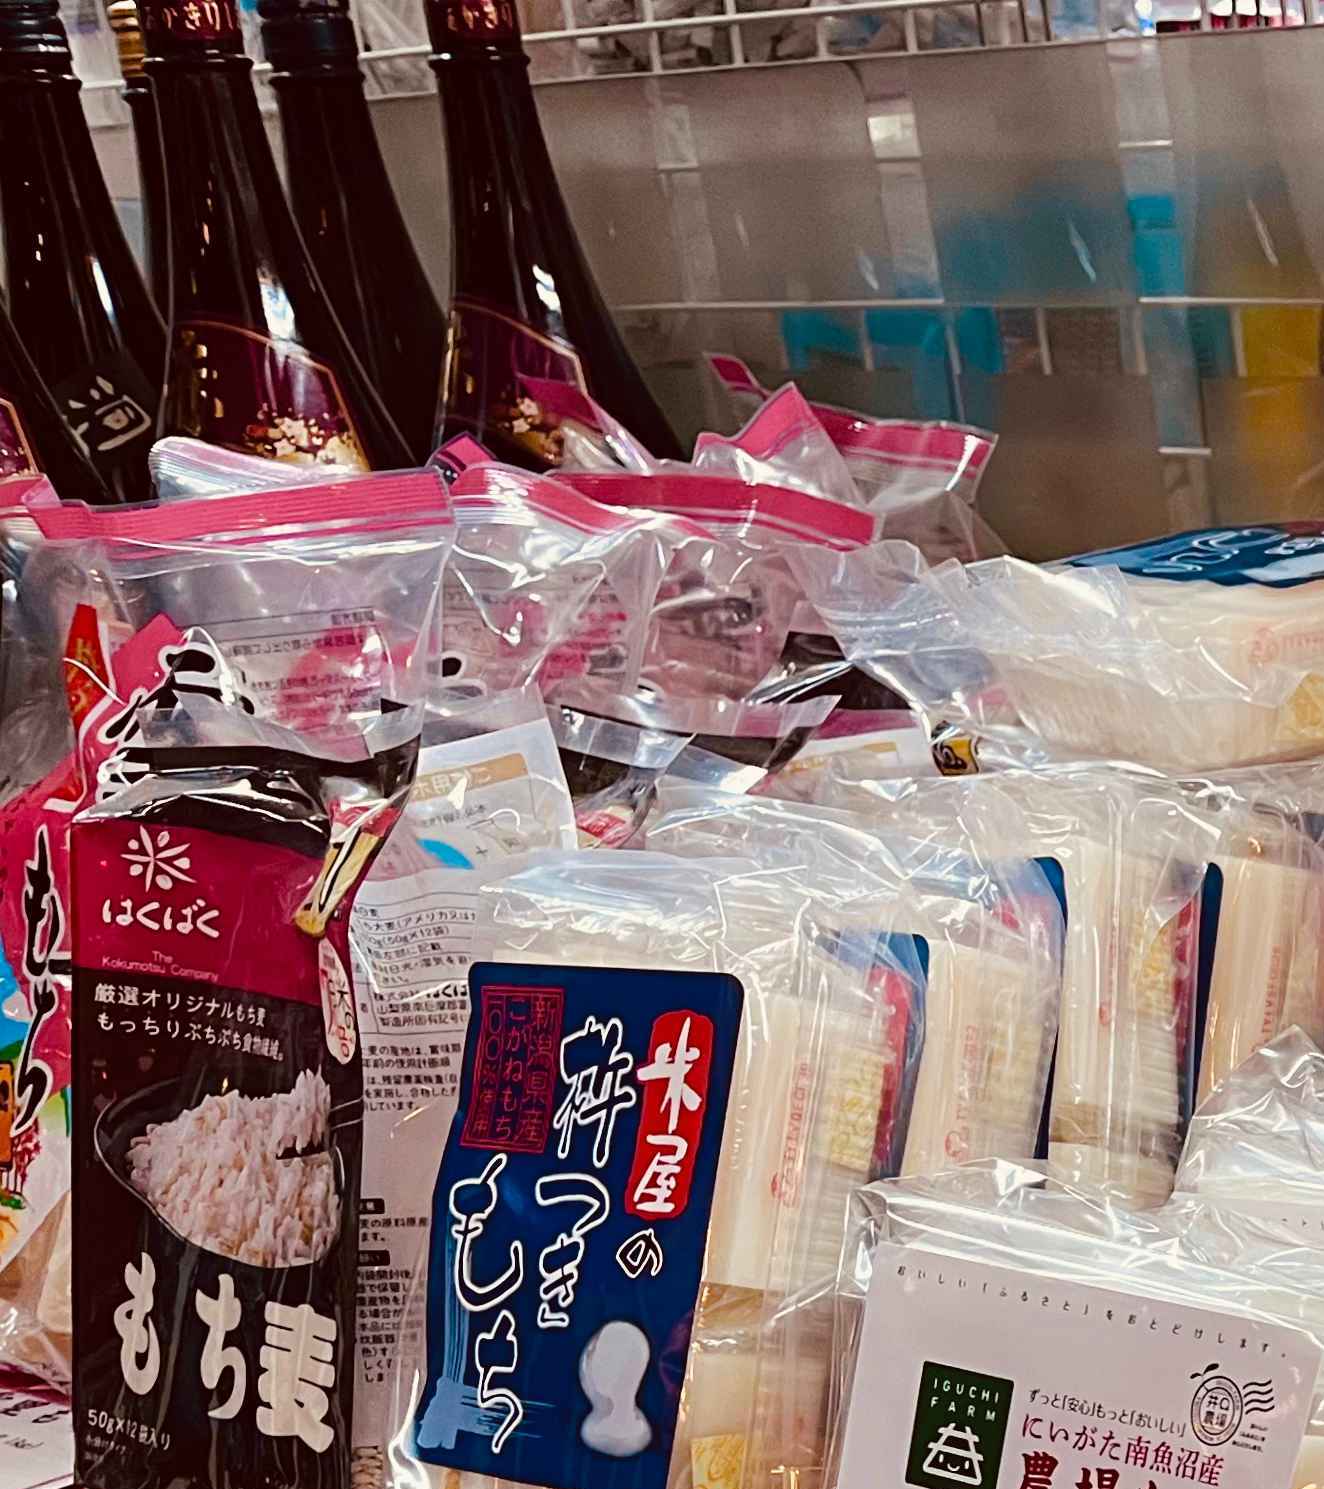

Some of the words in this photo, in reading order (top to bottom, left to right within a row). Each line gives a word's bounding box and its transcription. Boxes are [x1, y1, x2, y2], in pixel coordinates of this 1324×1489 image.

[102, 898, 220, 939] はくばく
[152, 950, 174, 963] The
[495, 995, 527, 1141] こがねもち
[113, 1252, 338, 1453] もち麦
[929, 1395, 997, 1422] FARM
[932, 1378, 1001, 1403] IGUCHI
[1022, 1414, 1225, 1489] にいがた南魚沼産
